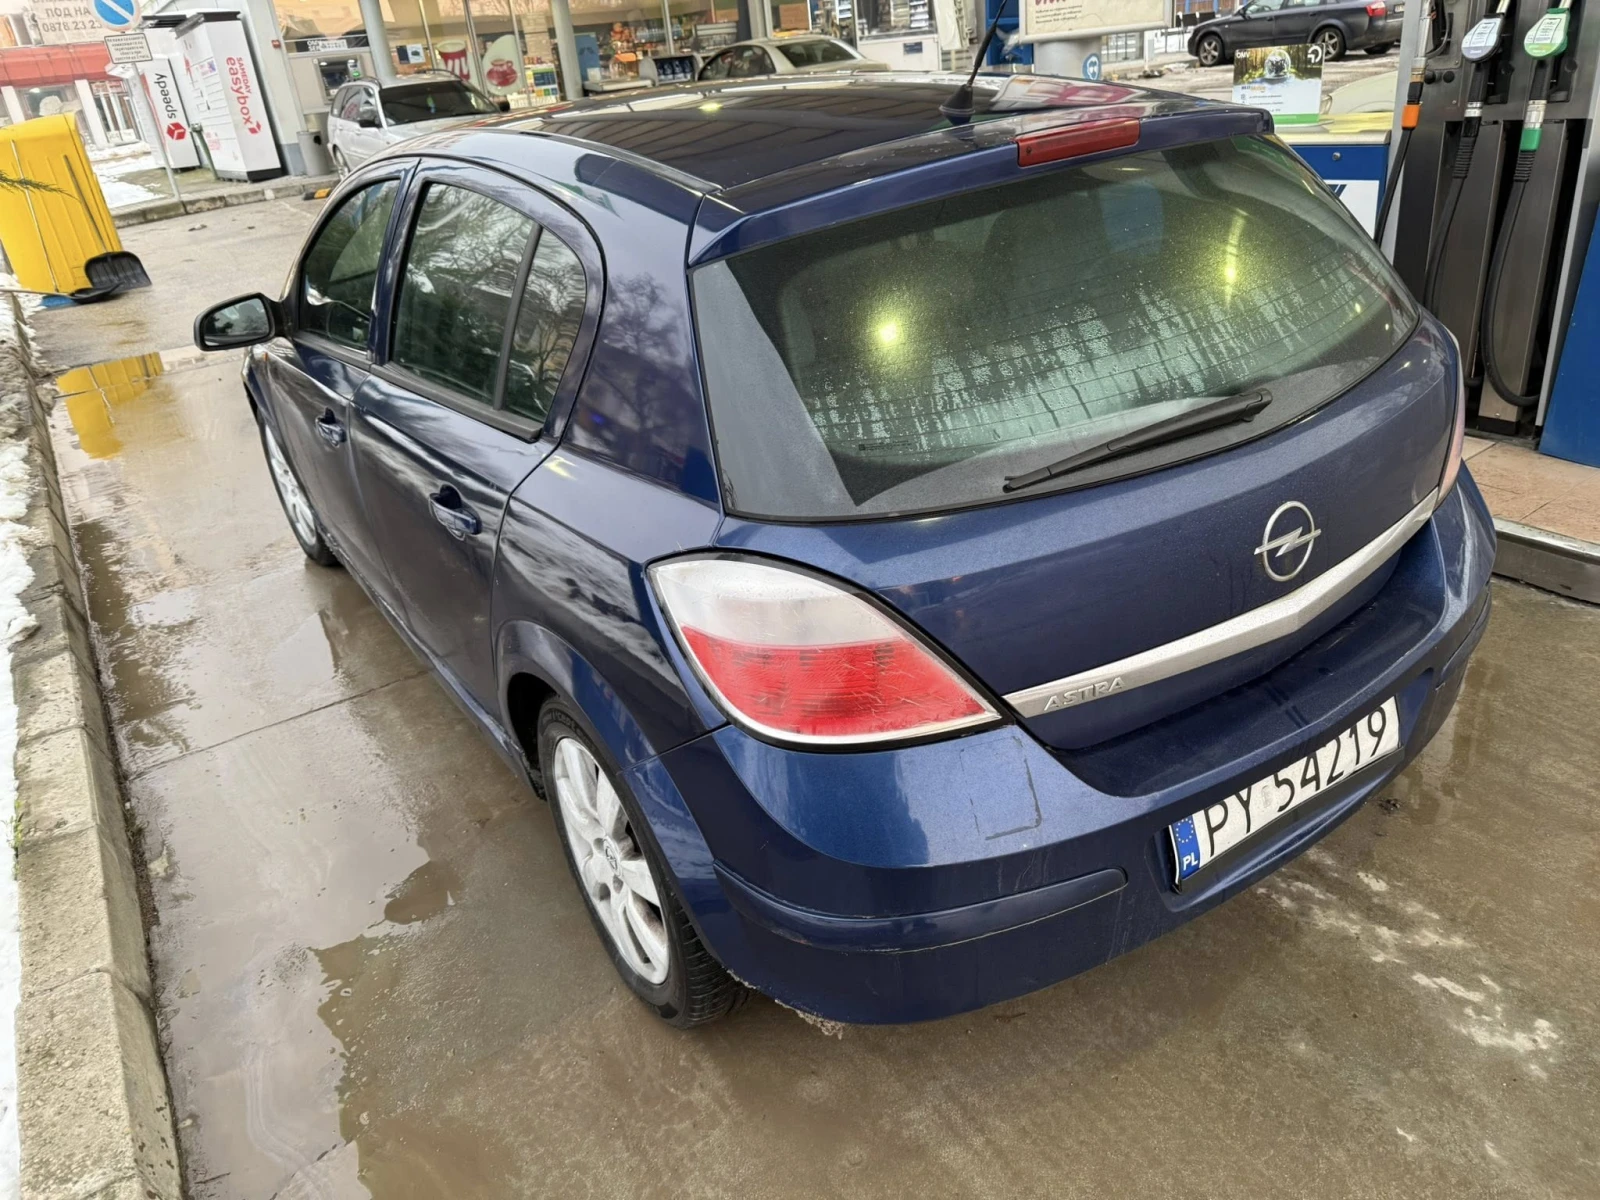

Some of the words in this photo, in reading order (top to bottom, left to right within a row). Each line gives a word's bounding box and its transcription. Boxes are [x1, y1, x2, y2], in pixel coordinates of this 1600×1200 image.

[45, 7, 72, 18] ПОД
[226, 57, 253, 125] easybox
[236, 57, 252, 94] SAMEDAY
[154, 73, 178, 119] speedy
[1043, 677, 1124, 711] ASTRA
[1203, 785, 1252, 857] PY
[1272, 706, 1387, 813] 54219
[1182, 855, 1199, 871] PL
